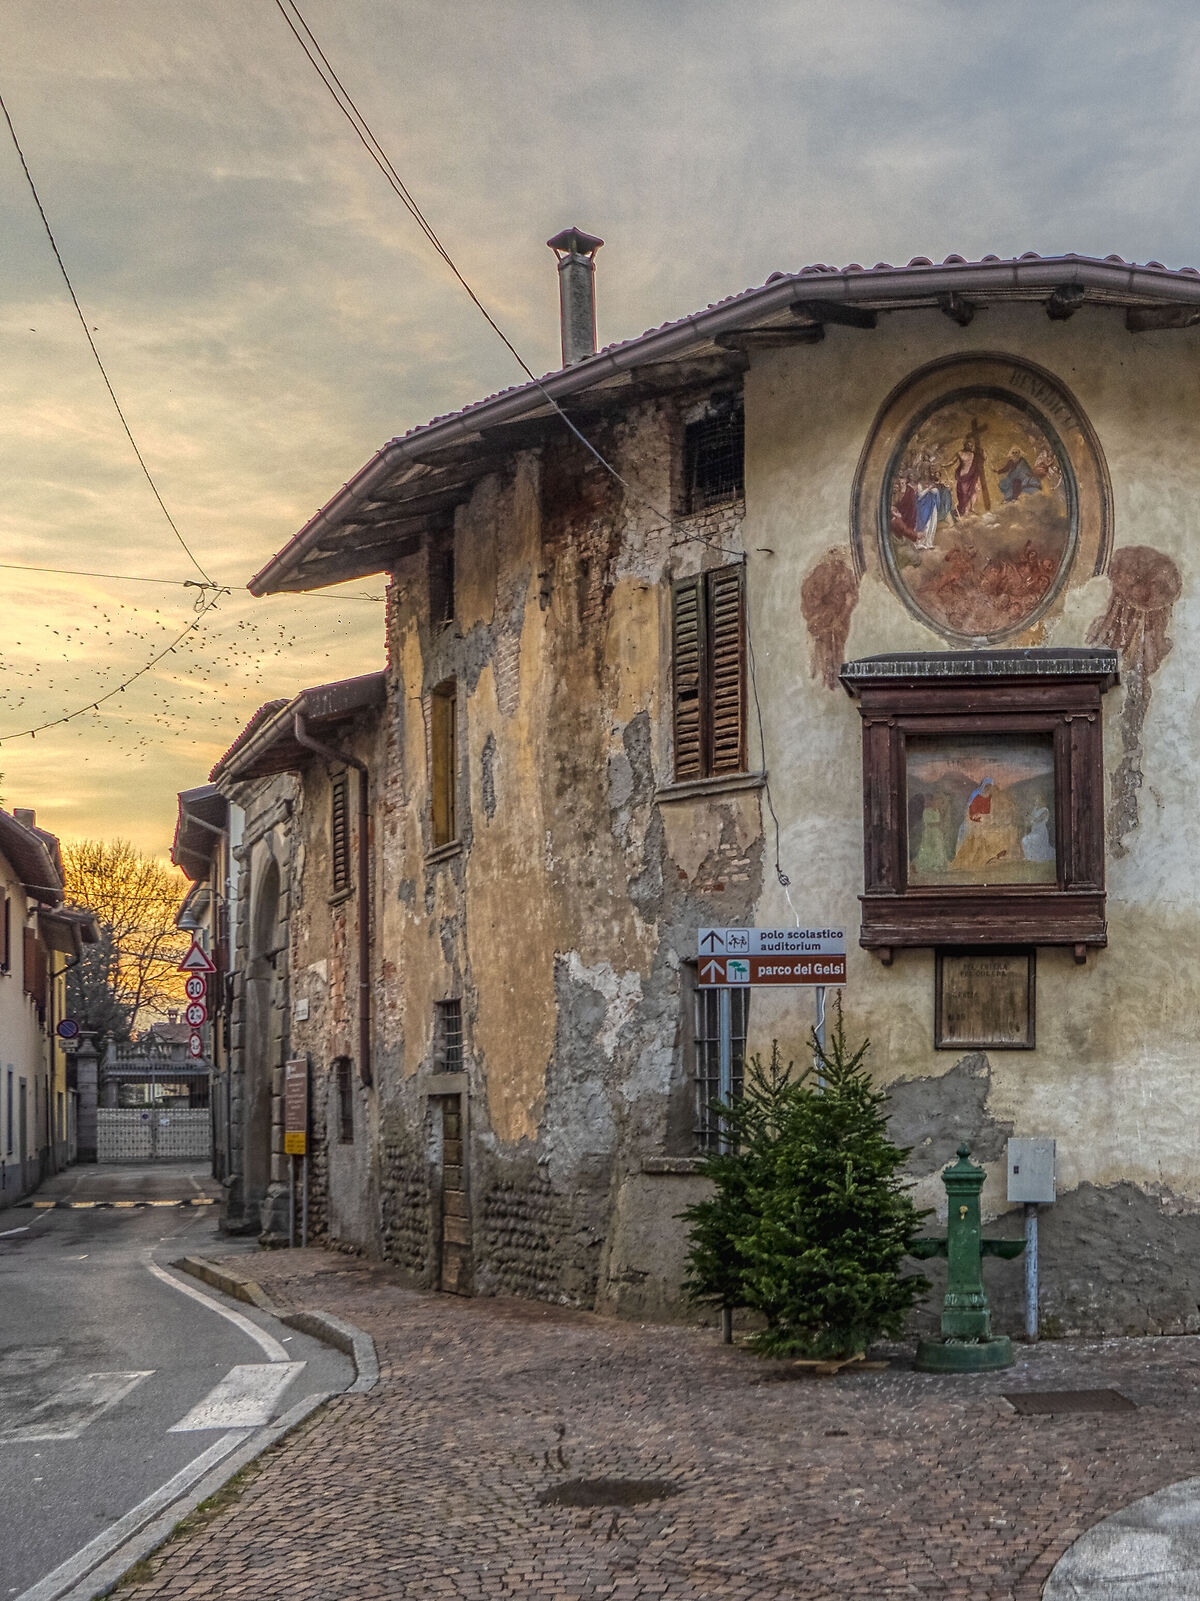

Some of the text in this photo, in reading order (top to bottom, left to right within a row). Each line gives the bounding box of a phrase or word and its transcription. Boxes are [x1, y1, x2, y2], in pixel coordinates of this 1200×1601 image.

[760, 929, 843, 940] polo scolastico
[760, 941, 821, 951] auditorium
[758, 962, 844, 977] parco dei Gelsi
[189, 981, 201, 995] 30
